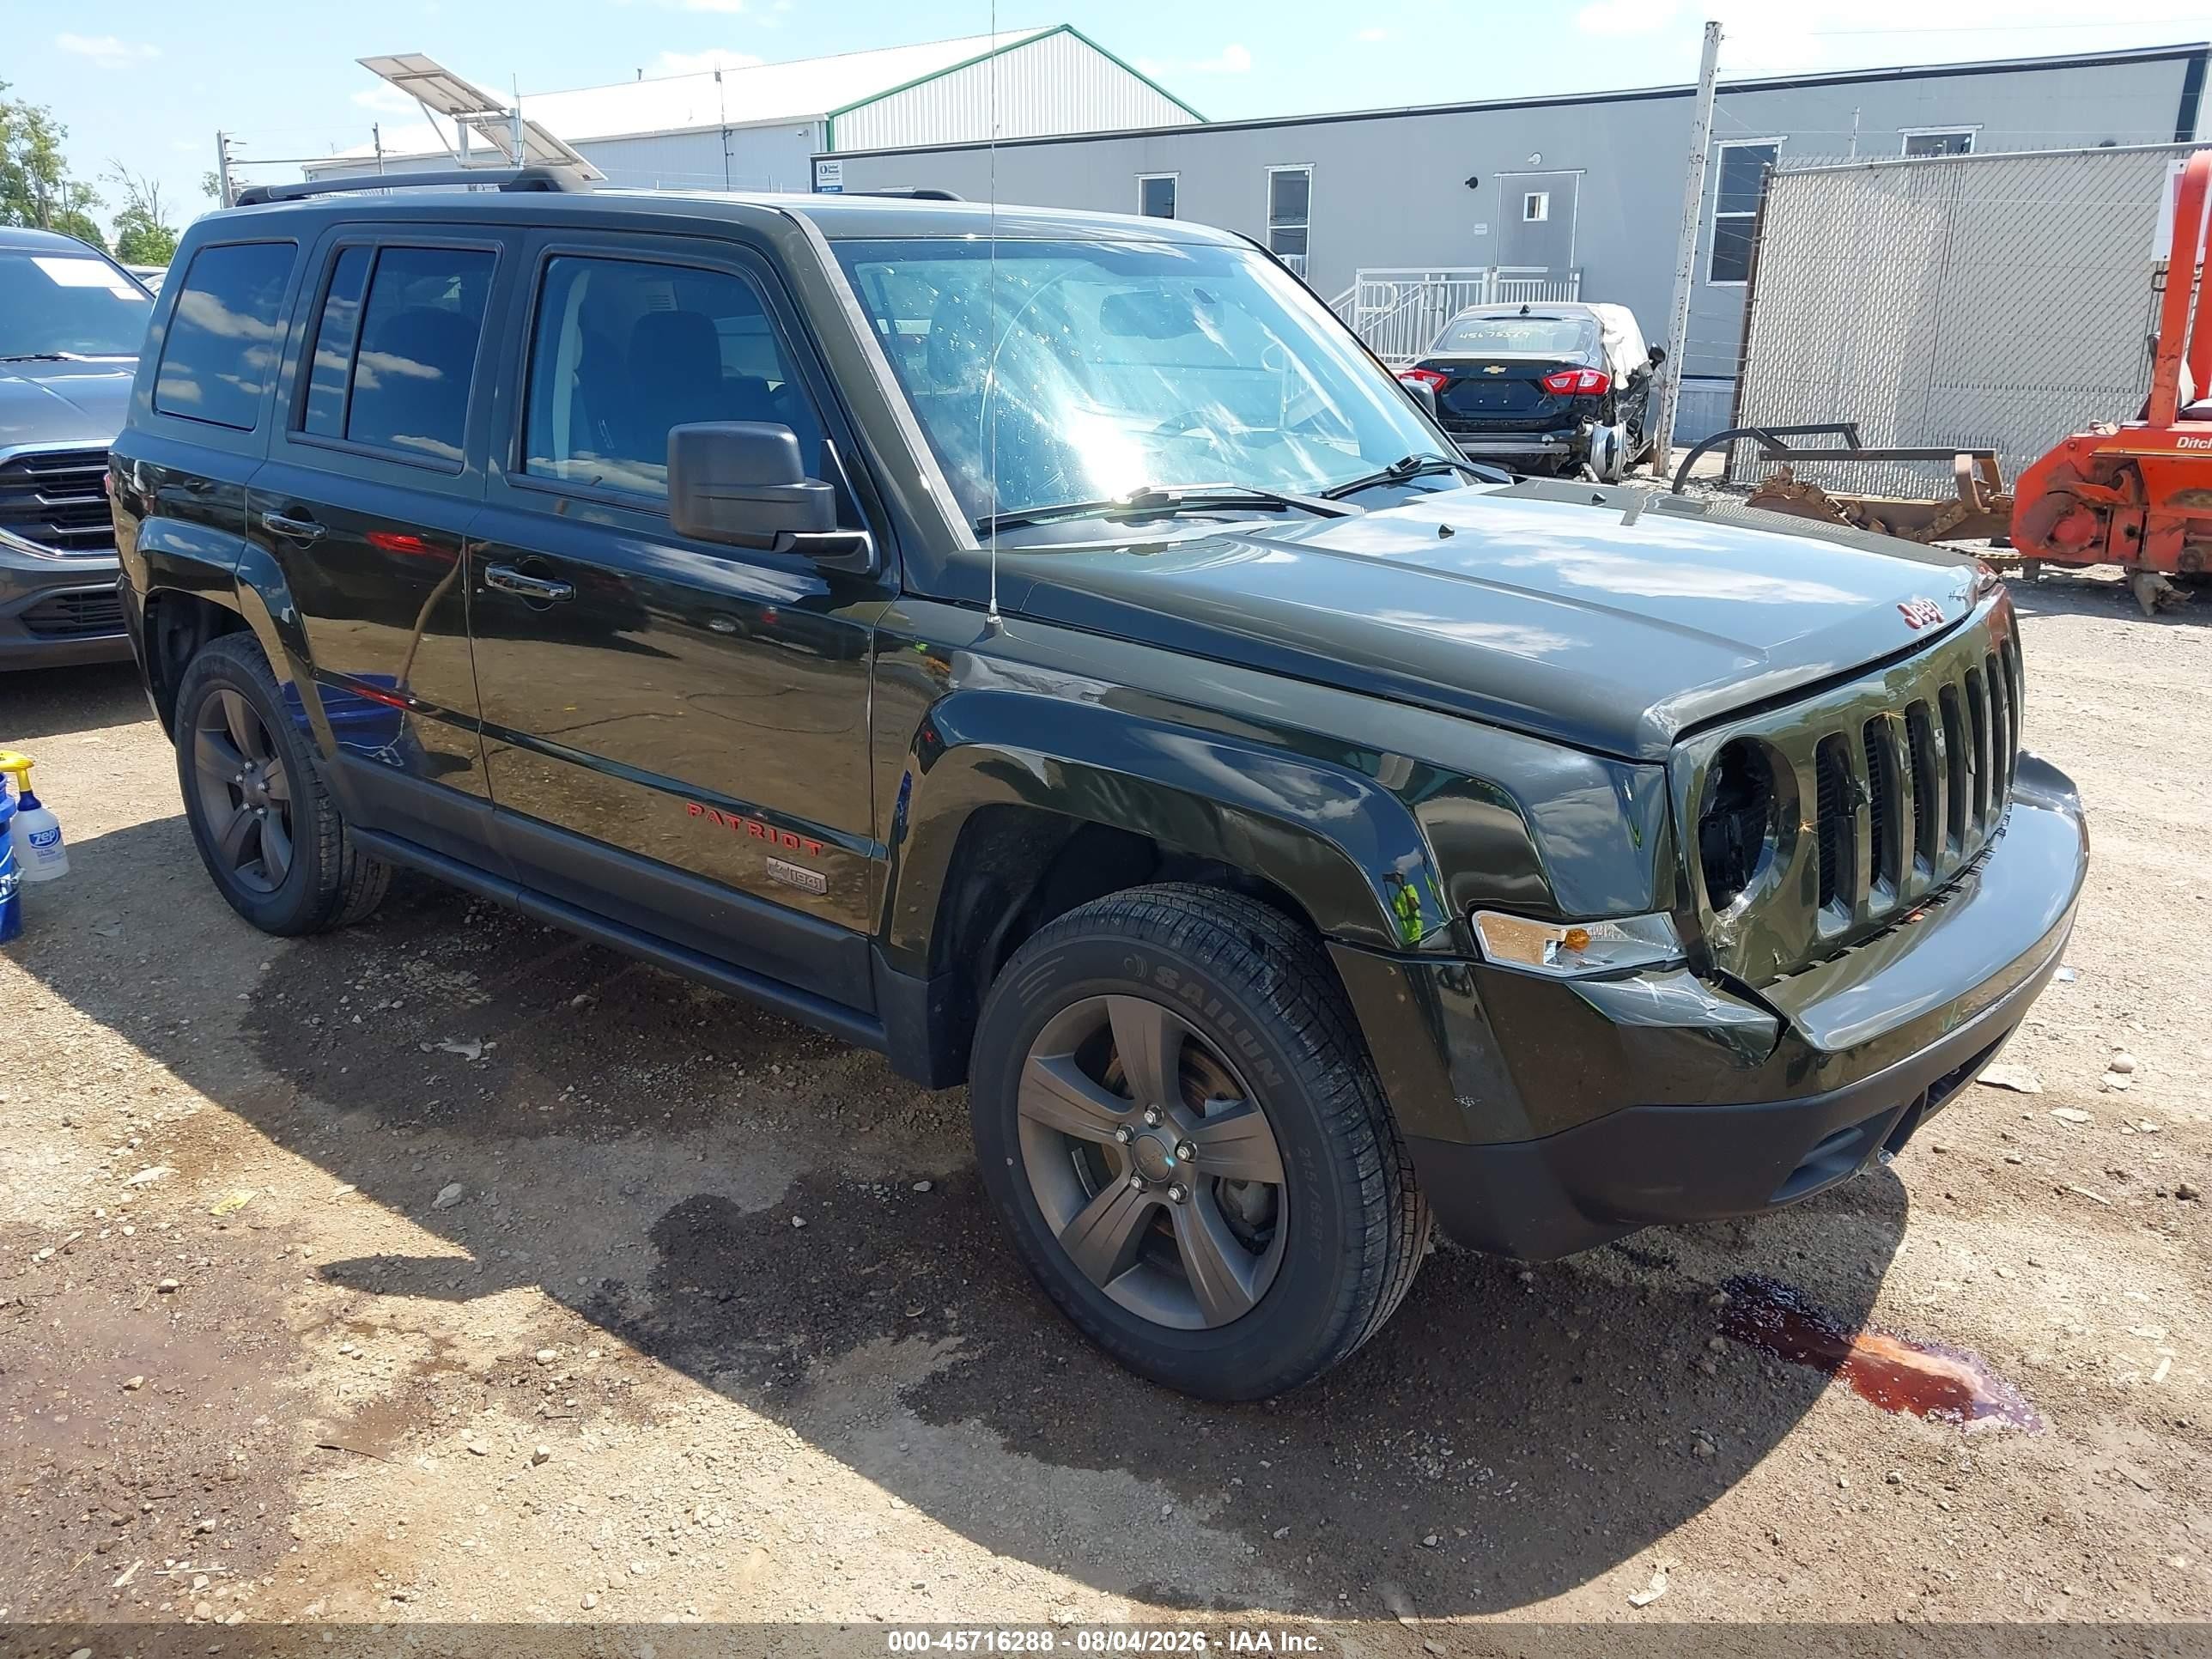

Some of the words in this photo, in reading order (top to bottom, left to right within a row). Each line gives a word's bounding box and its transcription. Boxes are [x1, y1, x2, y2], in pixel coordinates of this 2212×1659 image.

[1896, 598, 1945, 630] Jeep
[684, 802, 824, 857] PATRIOT
[790, 870, 822, 890] 1941
[1154, 965, 1285, 1086] SAILUN
